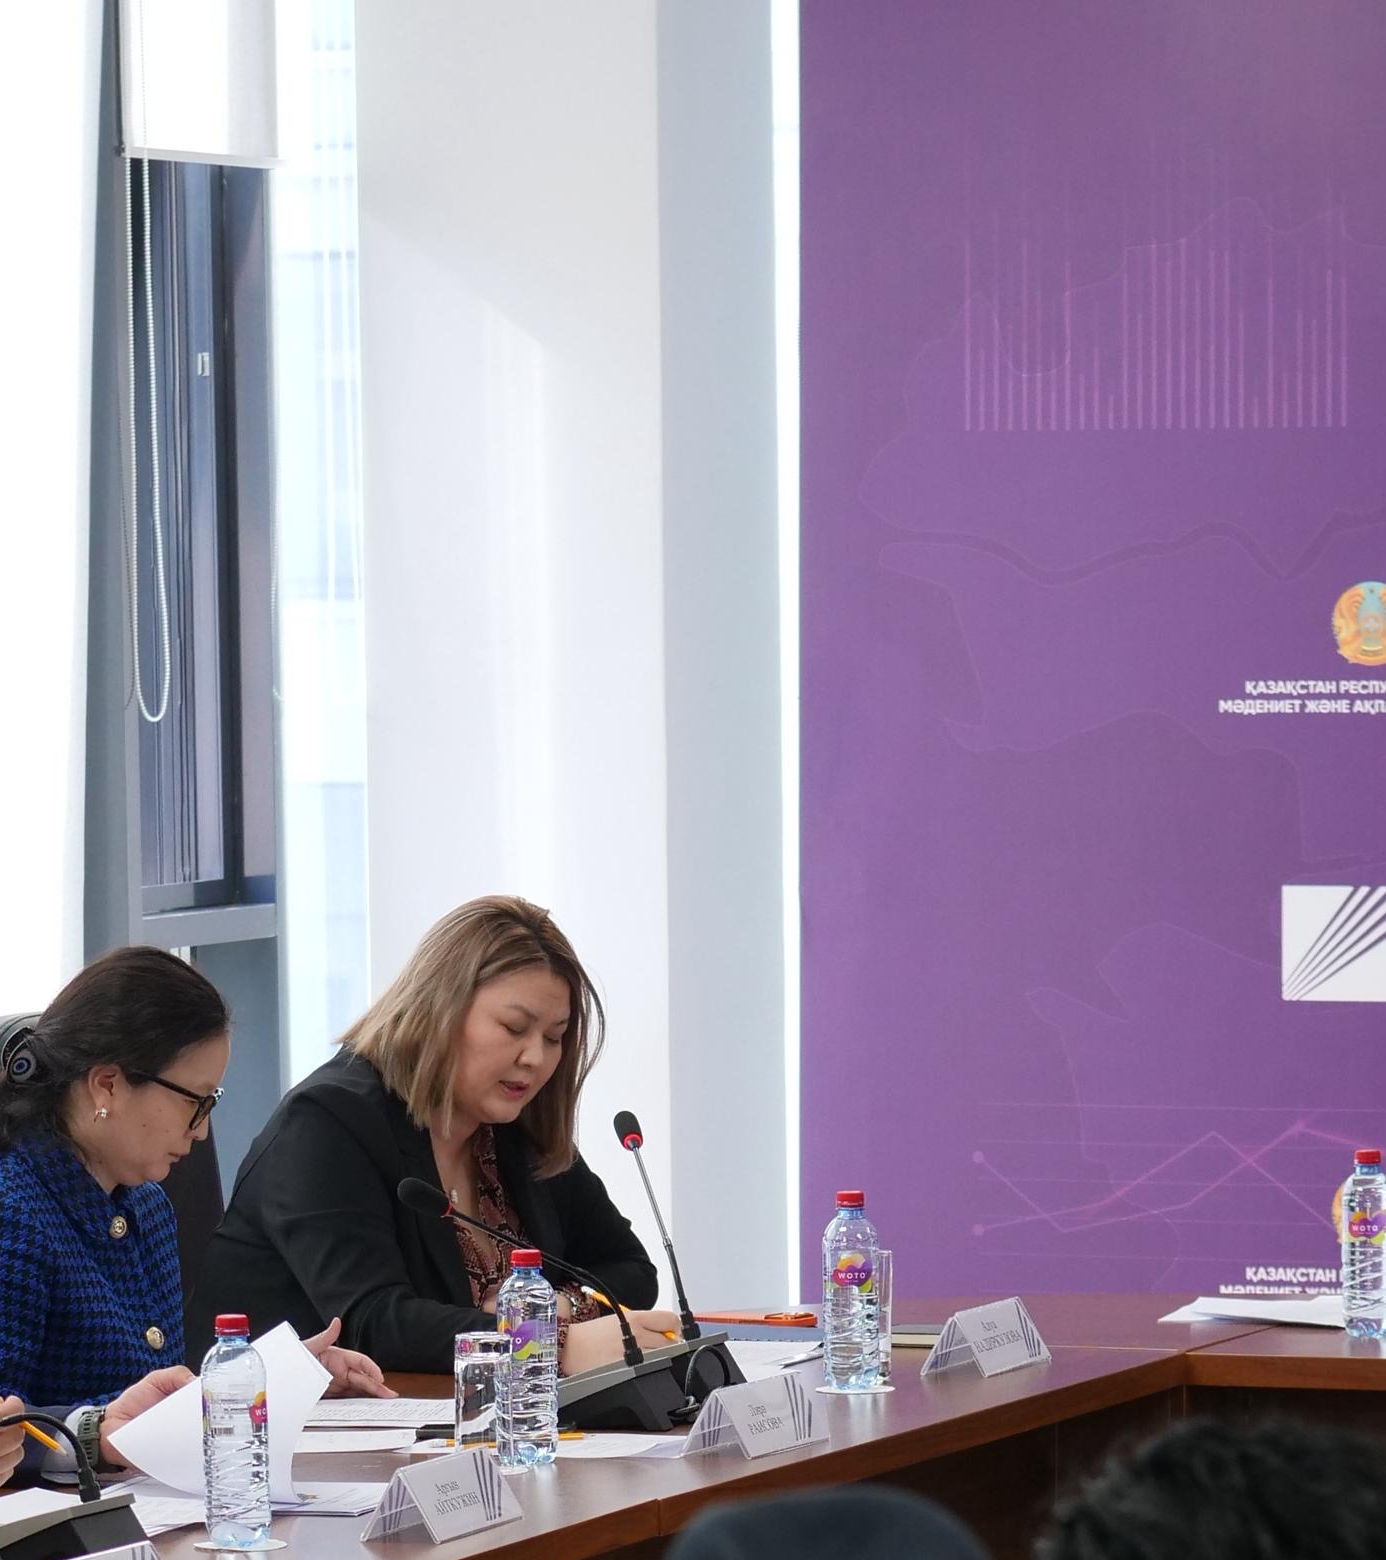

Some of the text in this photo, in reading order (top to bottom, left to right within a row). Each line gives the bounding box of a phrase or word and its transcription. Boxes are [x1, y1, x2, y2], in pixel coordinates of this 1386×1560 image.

[1244, 680, 1337, 697] ҚАЗАҚСТАН
[1218, 698, 1301, 716] МӘДЕНИЕТ
[1304, 698, 1351, 714] ЖӘНЕ
[837, 1272, 866, 1280] WOTO
[1245, 1266, 1337, 1283] ҚАЗАҚСТАН
